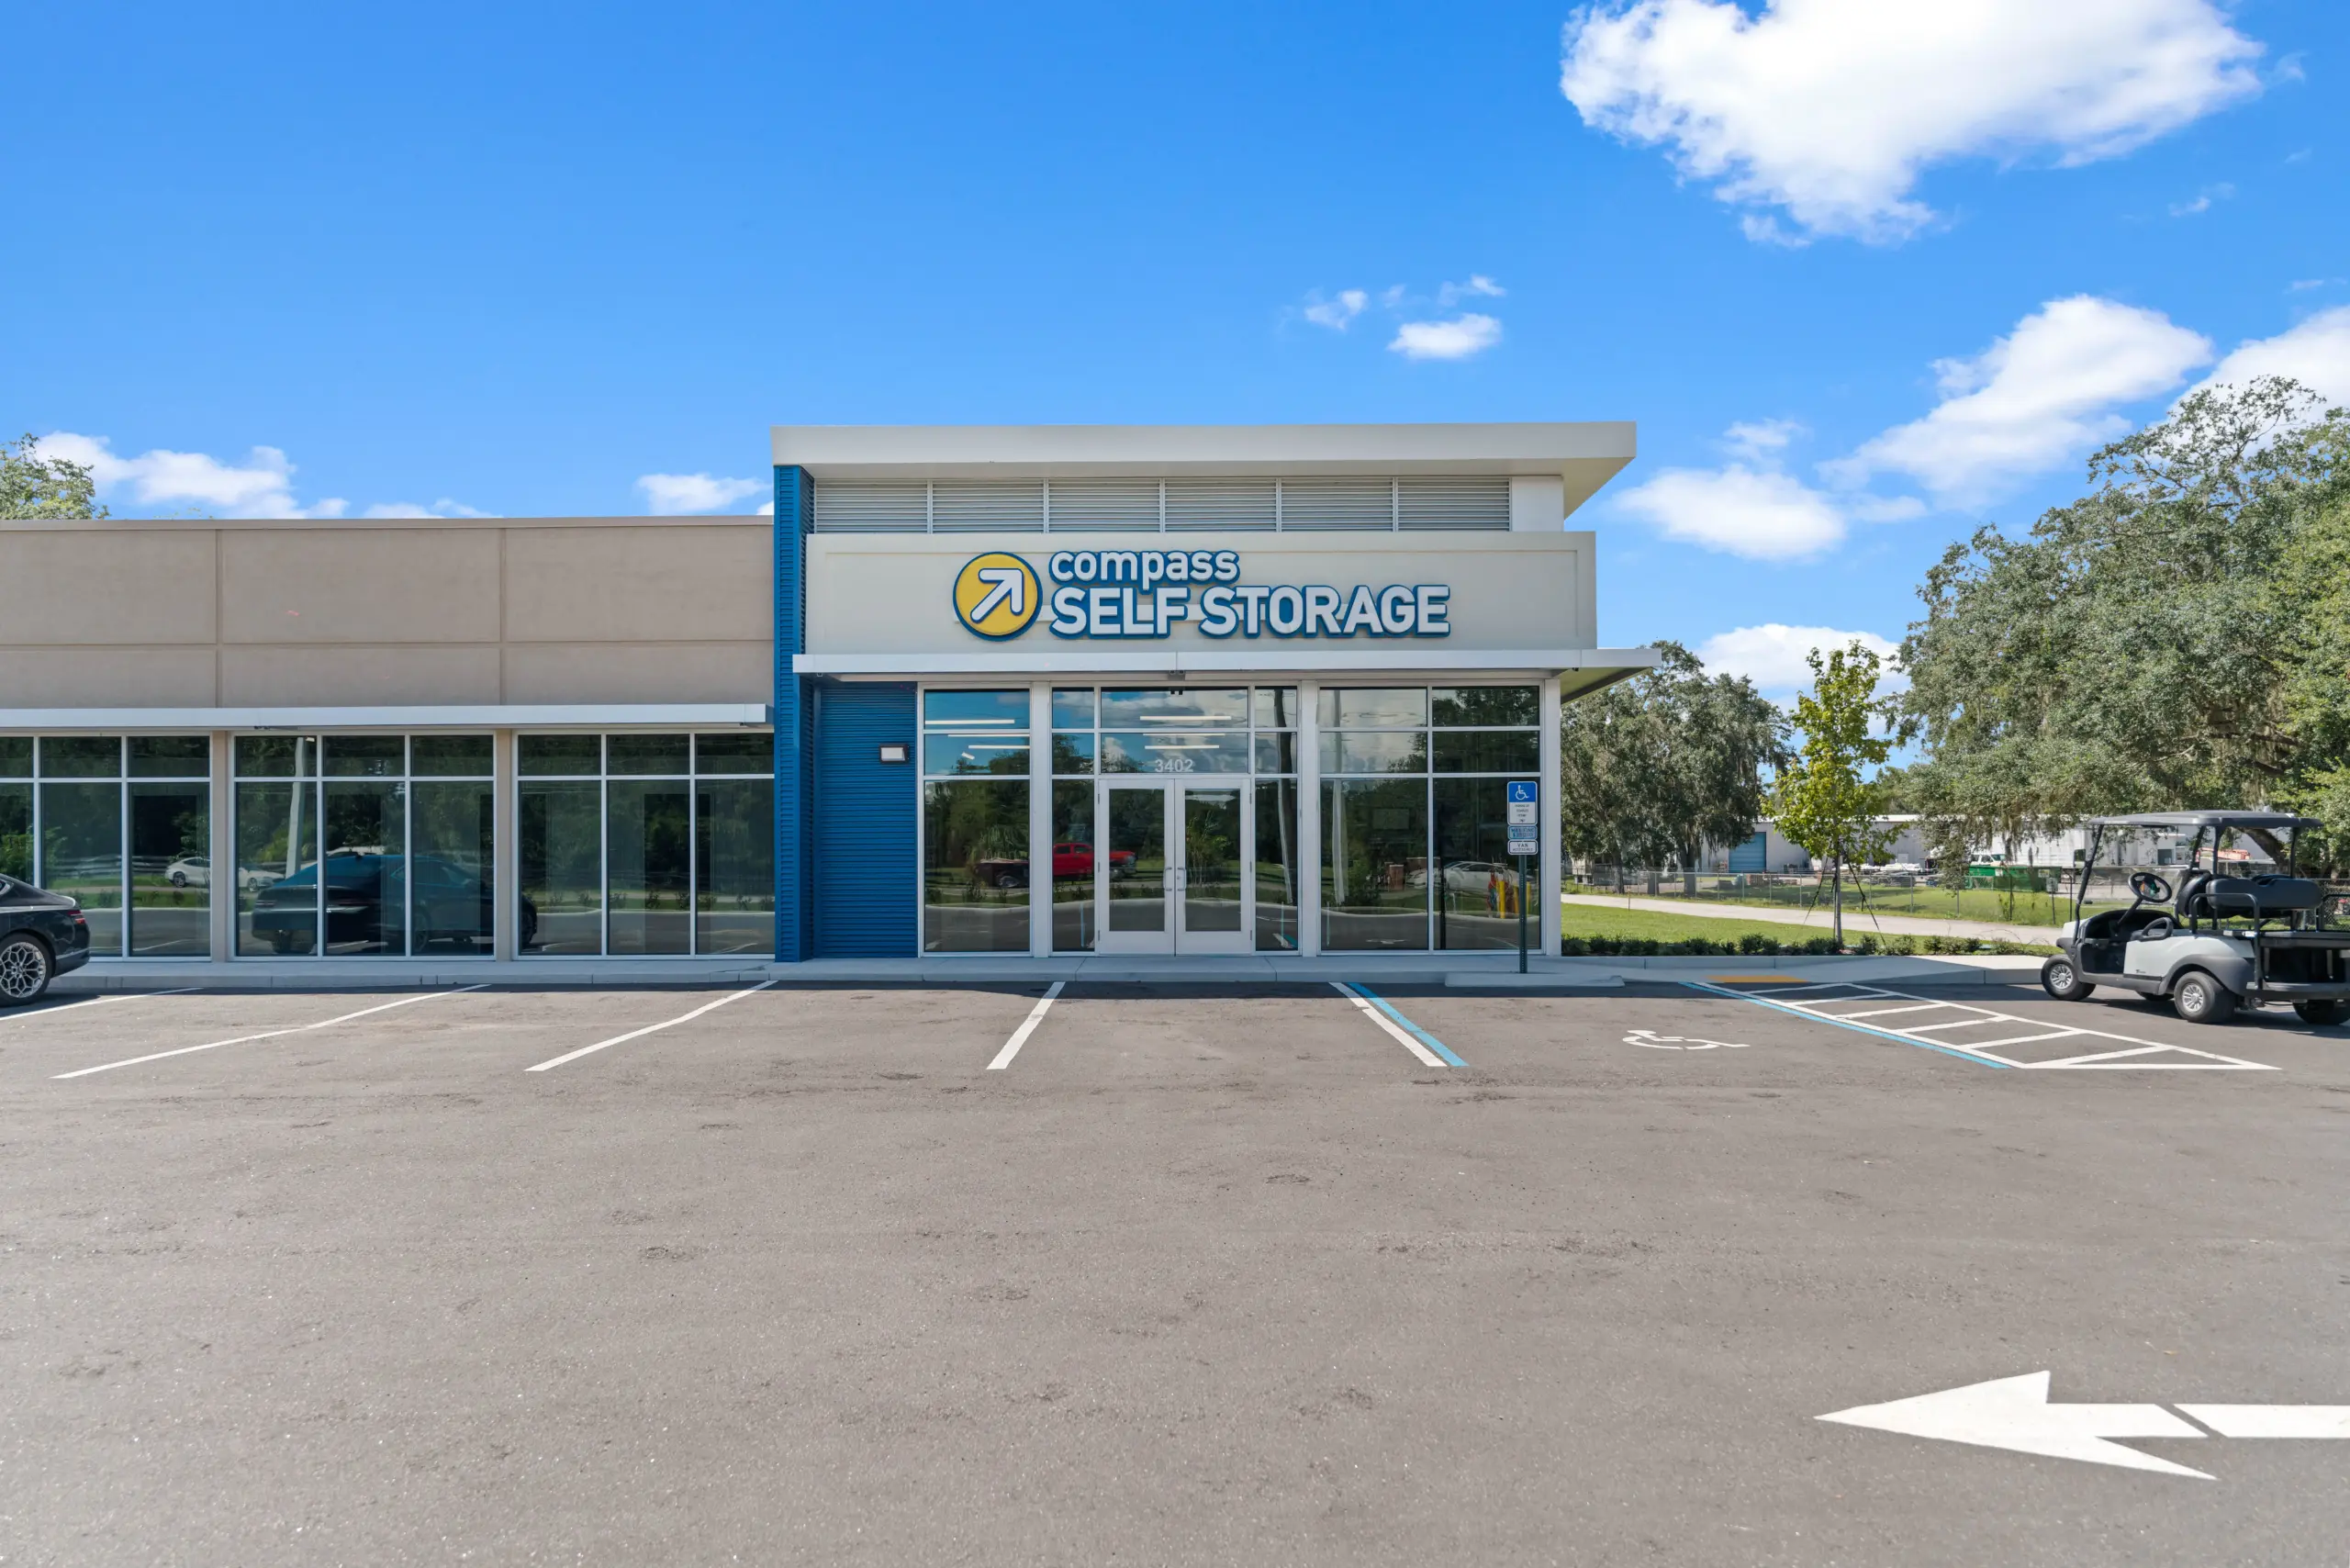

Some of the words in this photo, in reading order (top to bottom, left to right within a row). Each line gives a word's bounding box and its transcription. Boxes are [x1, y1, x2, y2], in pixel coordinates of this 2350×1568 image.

[1050, 551, 1239, 592] compass
[1050, 586, 1189, 636] SELF
[1199, 585, 1449, 636] STORAGE
[1155, 758, 1194, 773] 3402
